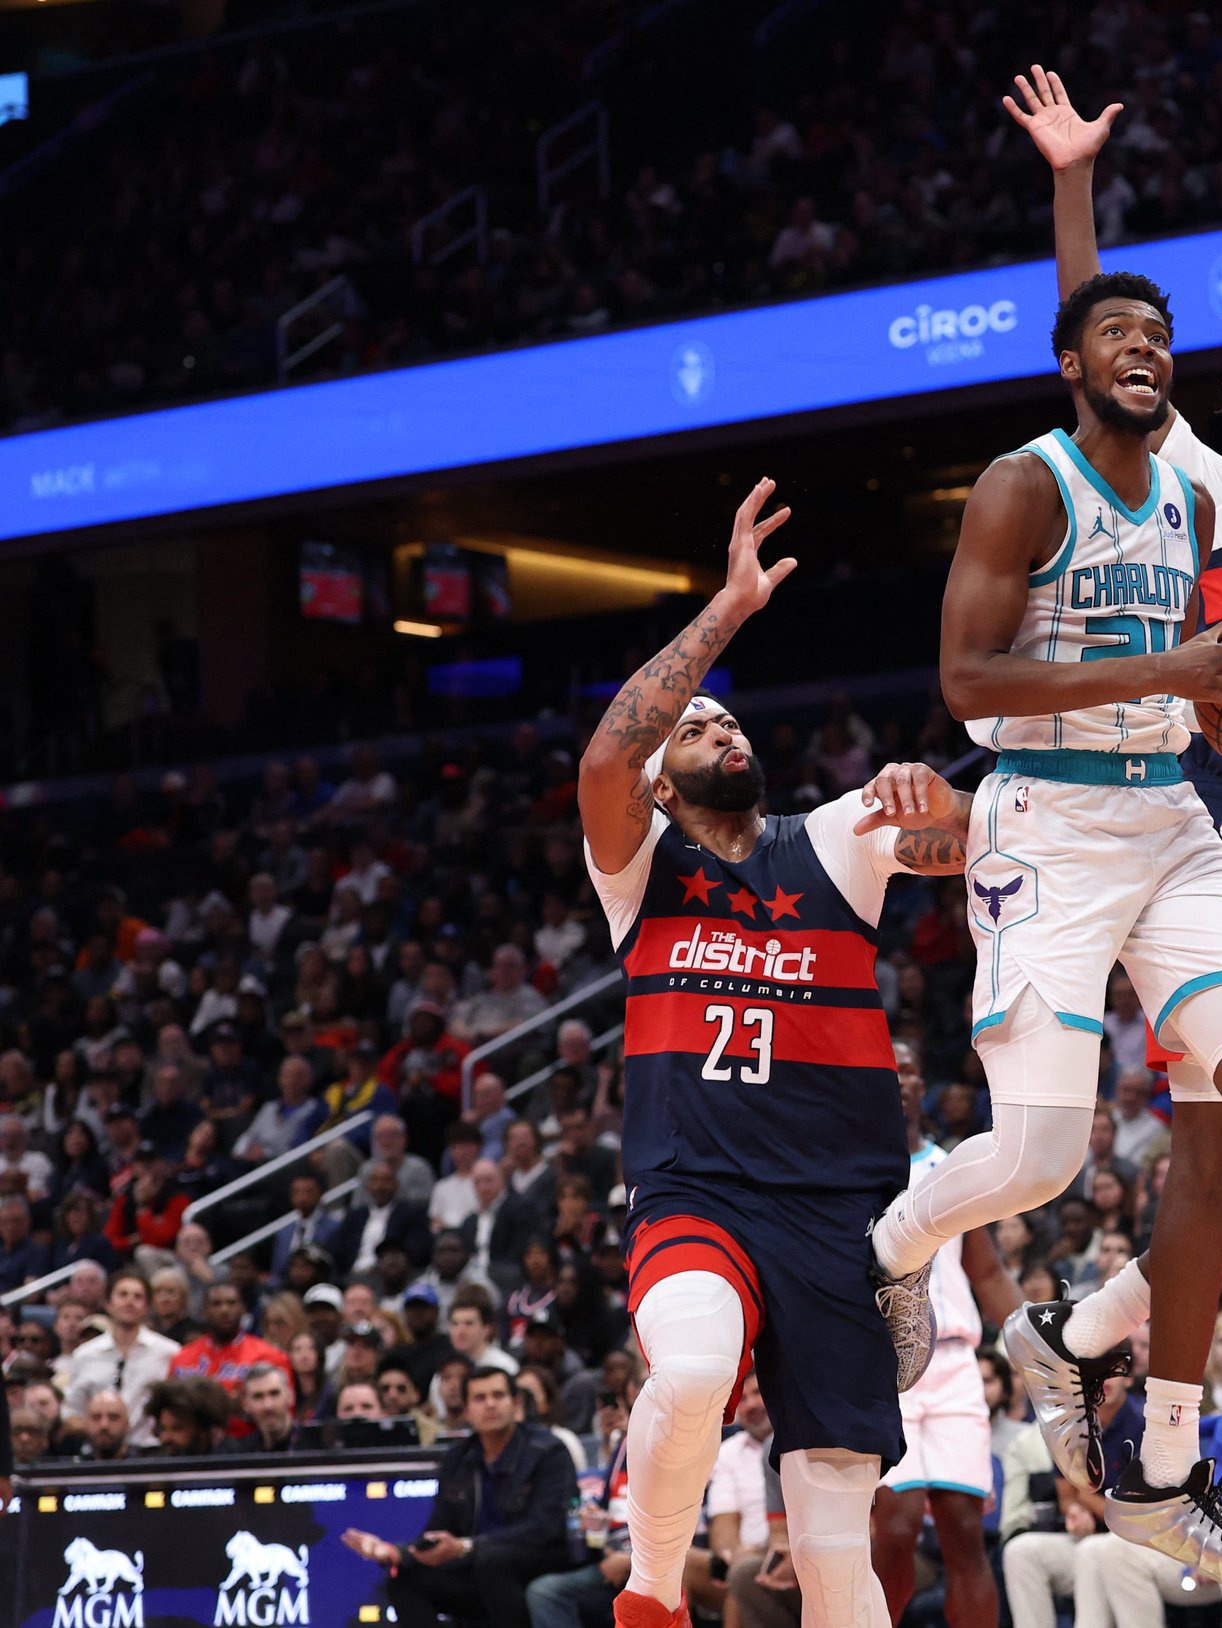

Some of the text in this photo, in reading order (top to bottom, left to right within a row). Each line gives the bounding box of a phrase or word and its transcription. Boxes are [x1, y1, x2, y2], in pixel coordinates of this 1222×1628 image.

[669, 923, 817, 981] district
[711, 931, 736, 943] THE
[669, 977, 812, 1000] OF COLUMBIA
[701, 1004, 774, 1085] 23
[53, 1593, 144, 1628] MGM
[214, 1586, 310, 1627] MGM
